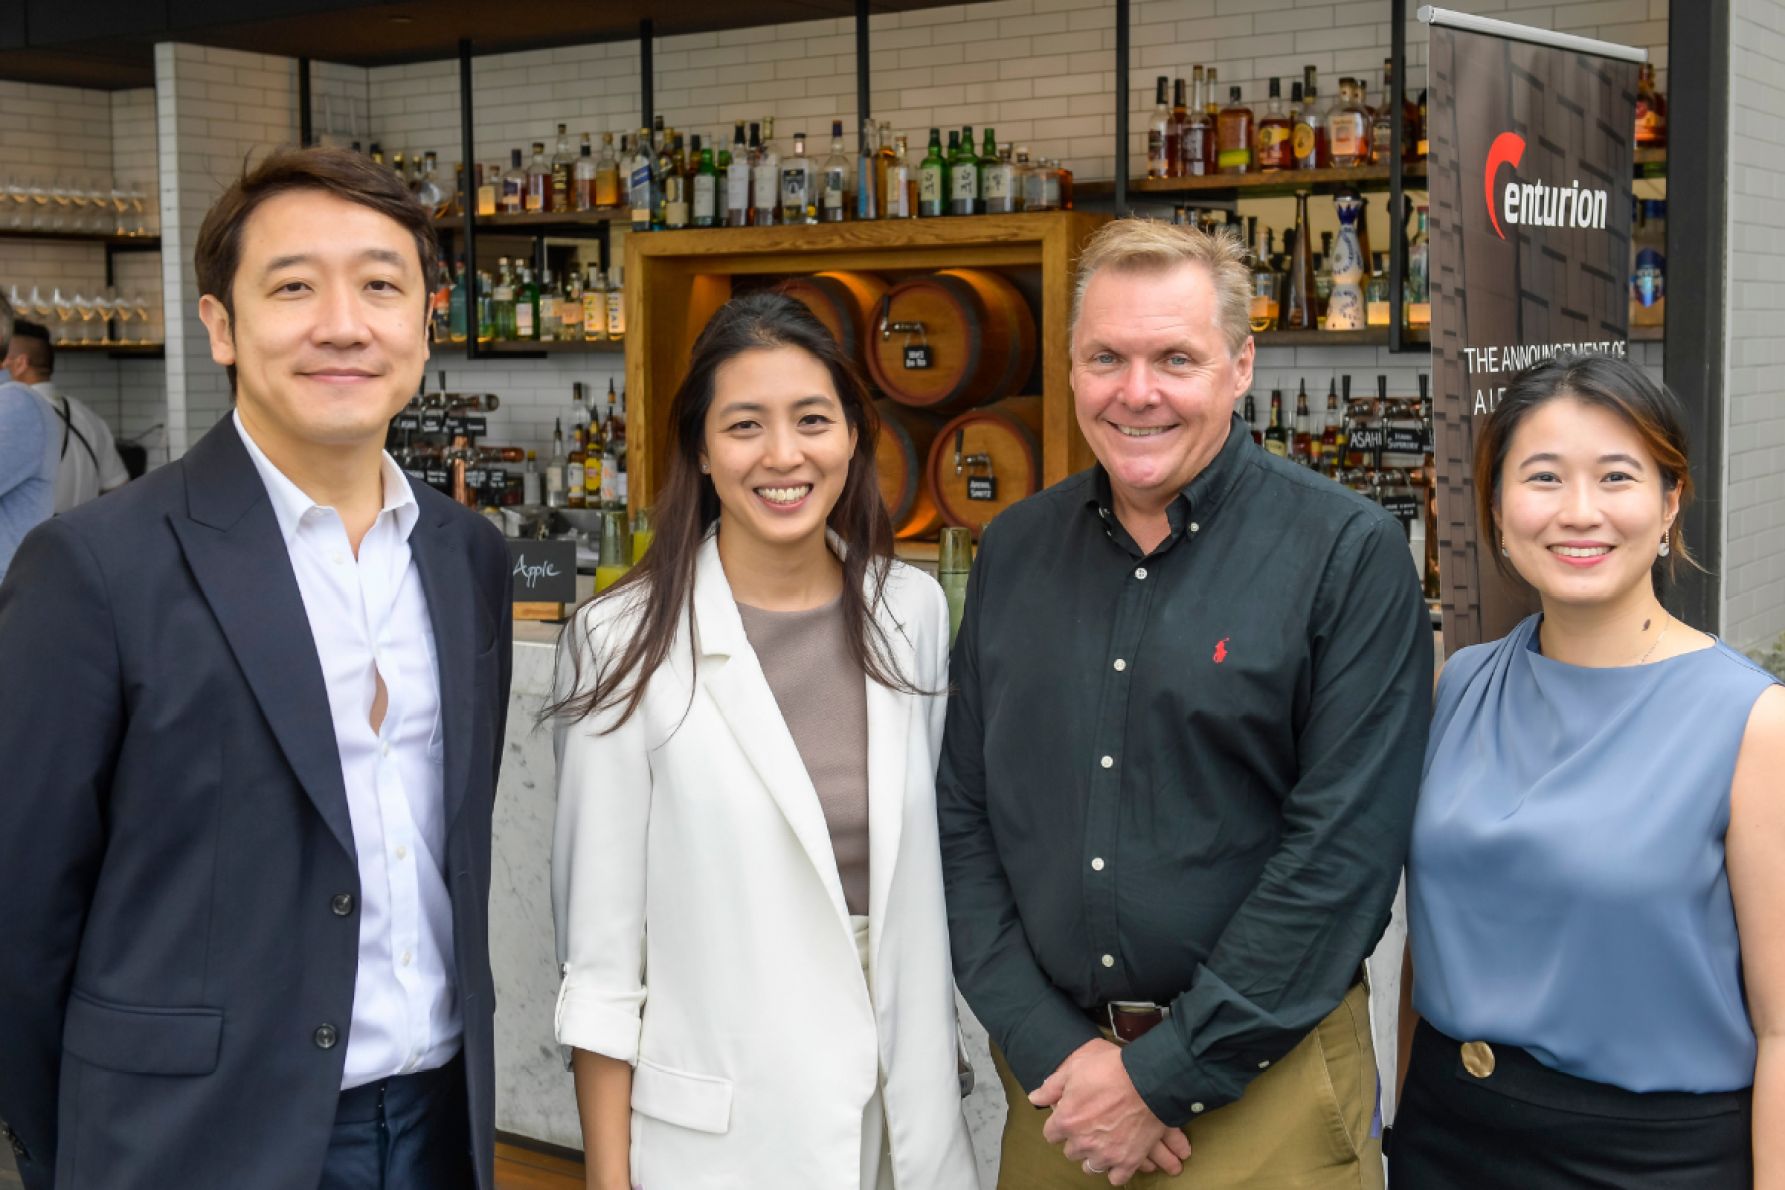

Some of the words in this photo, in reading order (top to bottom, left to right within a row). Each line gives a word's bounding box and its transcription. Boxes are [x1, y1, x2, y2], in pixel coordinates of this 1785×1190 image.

[1485, 131, 1607, 240] Centurion
[1464, 346, 1499, 374] THE
[1350, 431, 1383, 449] ASAHI
[512, 553, 562, 589] Apple
